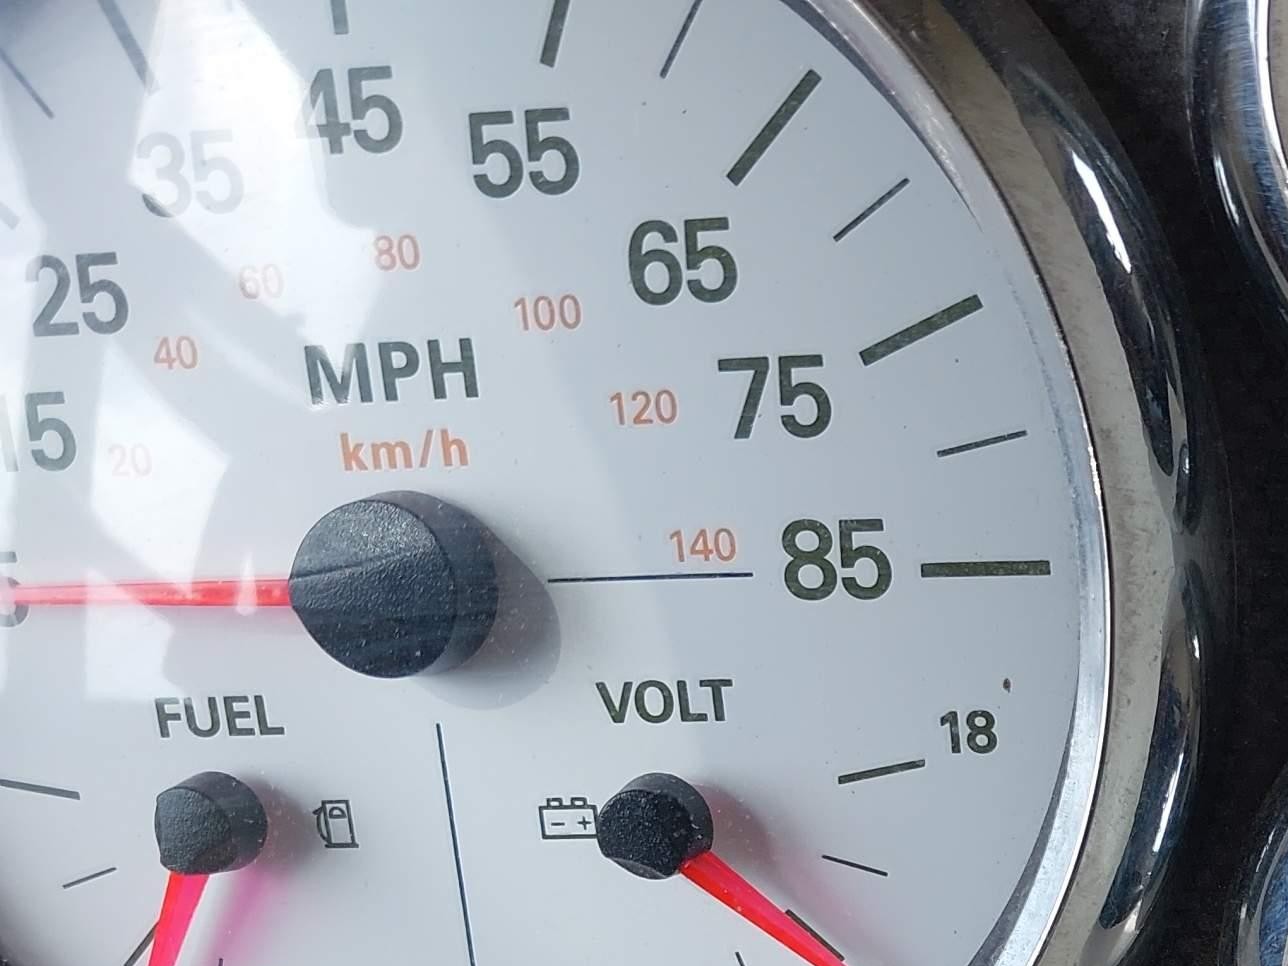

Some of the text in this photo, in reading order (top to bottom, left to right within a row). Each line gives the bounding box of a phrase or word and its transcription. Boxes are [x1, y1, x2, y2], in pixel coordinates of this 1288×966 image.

[297, 65, 403, 154] 45
[136, 129, 244, 217] 35
[469, 107, 580, 198] 55
[373, 234, 420, 271] 80
[627, 216, 738, 305] 65
[25, 251, 129, 337] 25
[238, 264, 283, 299] 60
[514, 294, 582, 331] 100
[153, 336, 198, 369] 40
[303, 337, 480, 405] MPH
[609, 389, 678, 425] 120
[718, 354, 832, 439] 75
[108, 443, 152, 477] 20
[340, 428, 470, 471] km/h
[668, 529, 737, 562] 140
[781, 518, 892, 600] 85
[155, 695, 285, 738] FUEL
[596, 678, 734, 723] VOLT
[940, 710, 998, 754] 18
